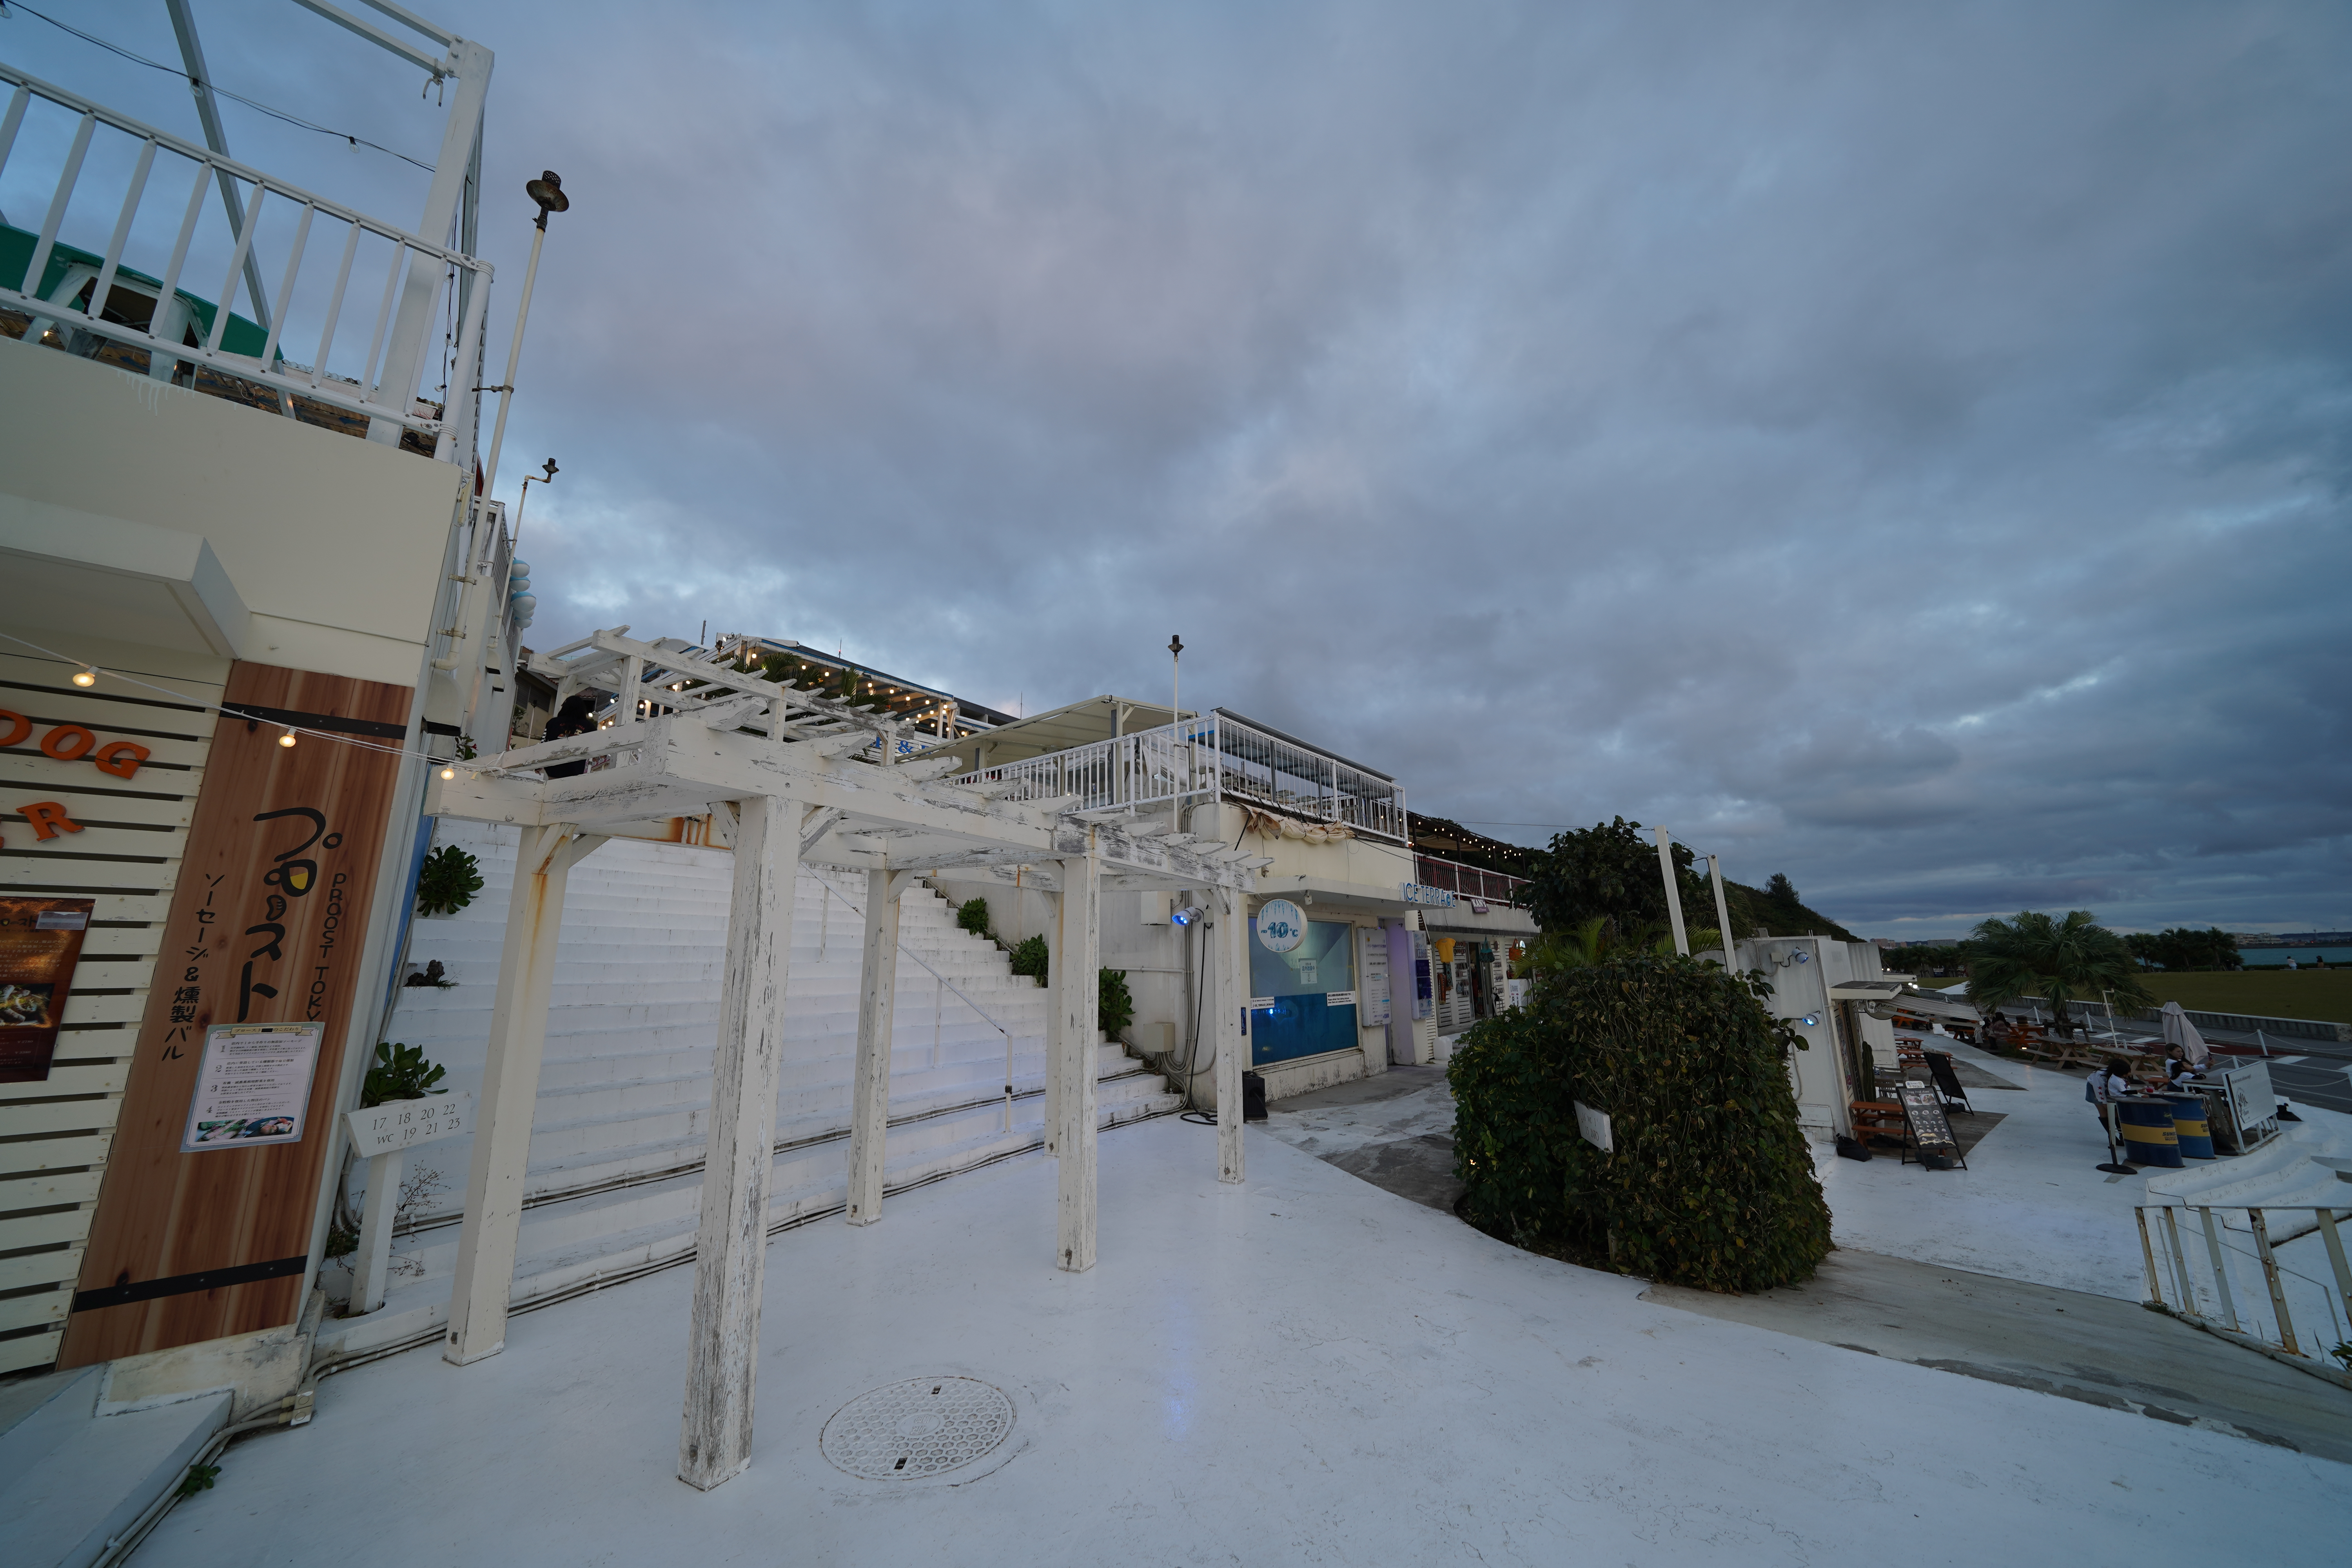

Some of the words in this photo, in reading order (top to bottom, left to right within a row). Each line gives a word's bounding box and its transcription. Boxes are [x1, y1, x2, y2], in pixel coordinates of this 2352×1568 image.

[0, 802, 85, 849] R
[1403, 882, 1418, 902] ICE
[1421, 886, 1456, 907] TERRACE
[373, 1117, 387, 1130] 17
[398, 1112, 410, 1125] 18
[420, 1108, 434, 1120] 20
[443, 1103, 455, 1115] 22
[377, 1134, 394, 1144] WC
[403, 1127, 416, 1140] 19
[425, 1123, 437, 1135] 21
[448, 1118, 460, 1130] 23
